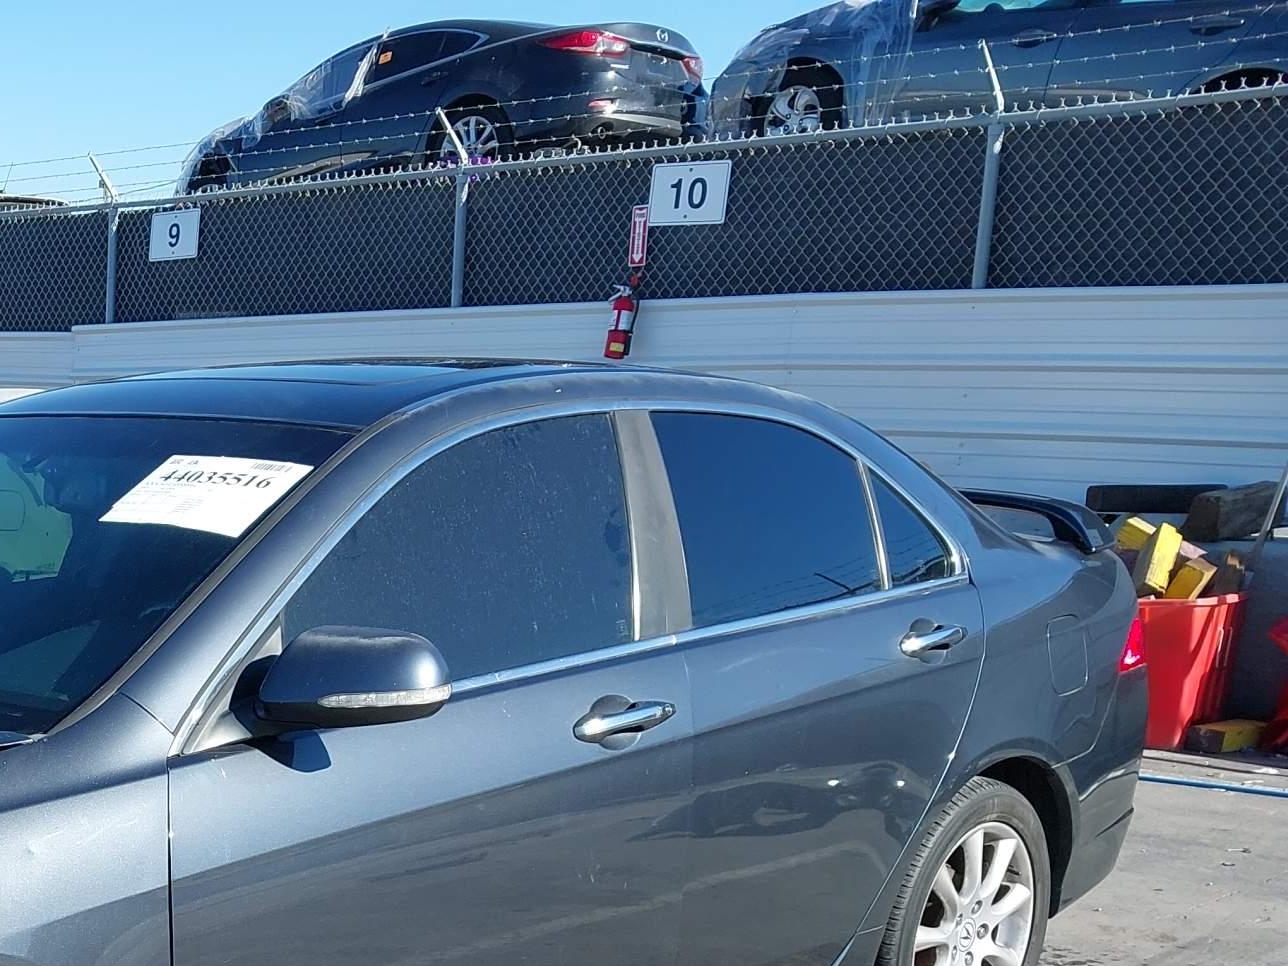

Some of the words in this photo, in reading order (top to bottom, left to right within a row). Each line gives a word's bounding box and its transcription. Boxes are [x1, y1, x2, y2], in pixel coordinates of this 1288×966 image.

[670, 177, 708, 210] 10
[168, 222, 181, 248] 9
[159, 469, 277, 489] 44035516
